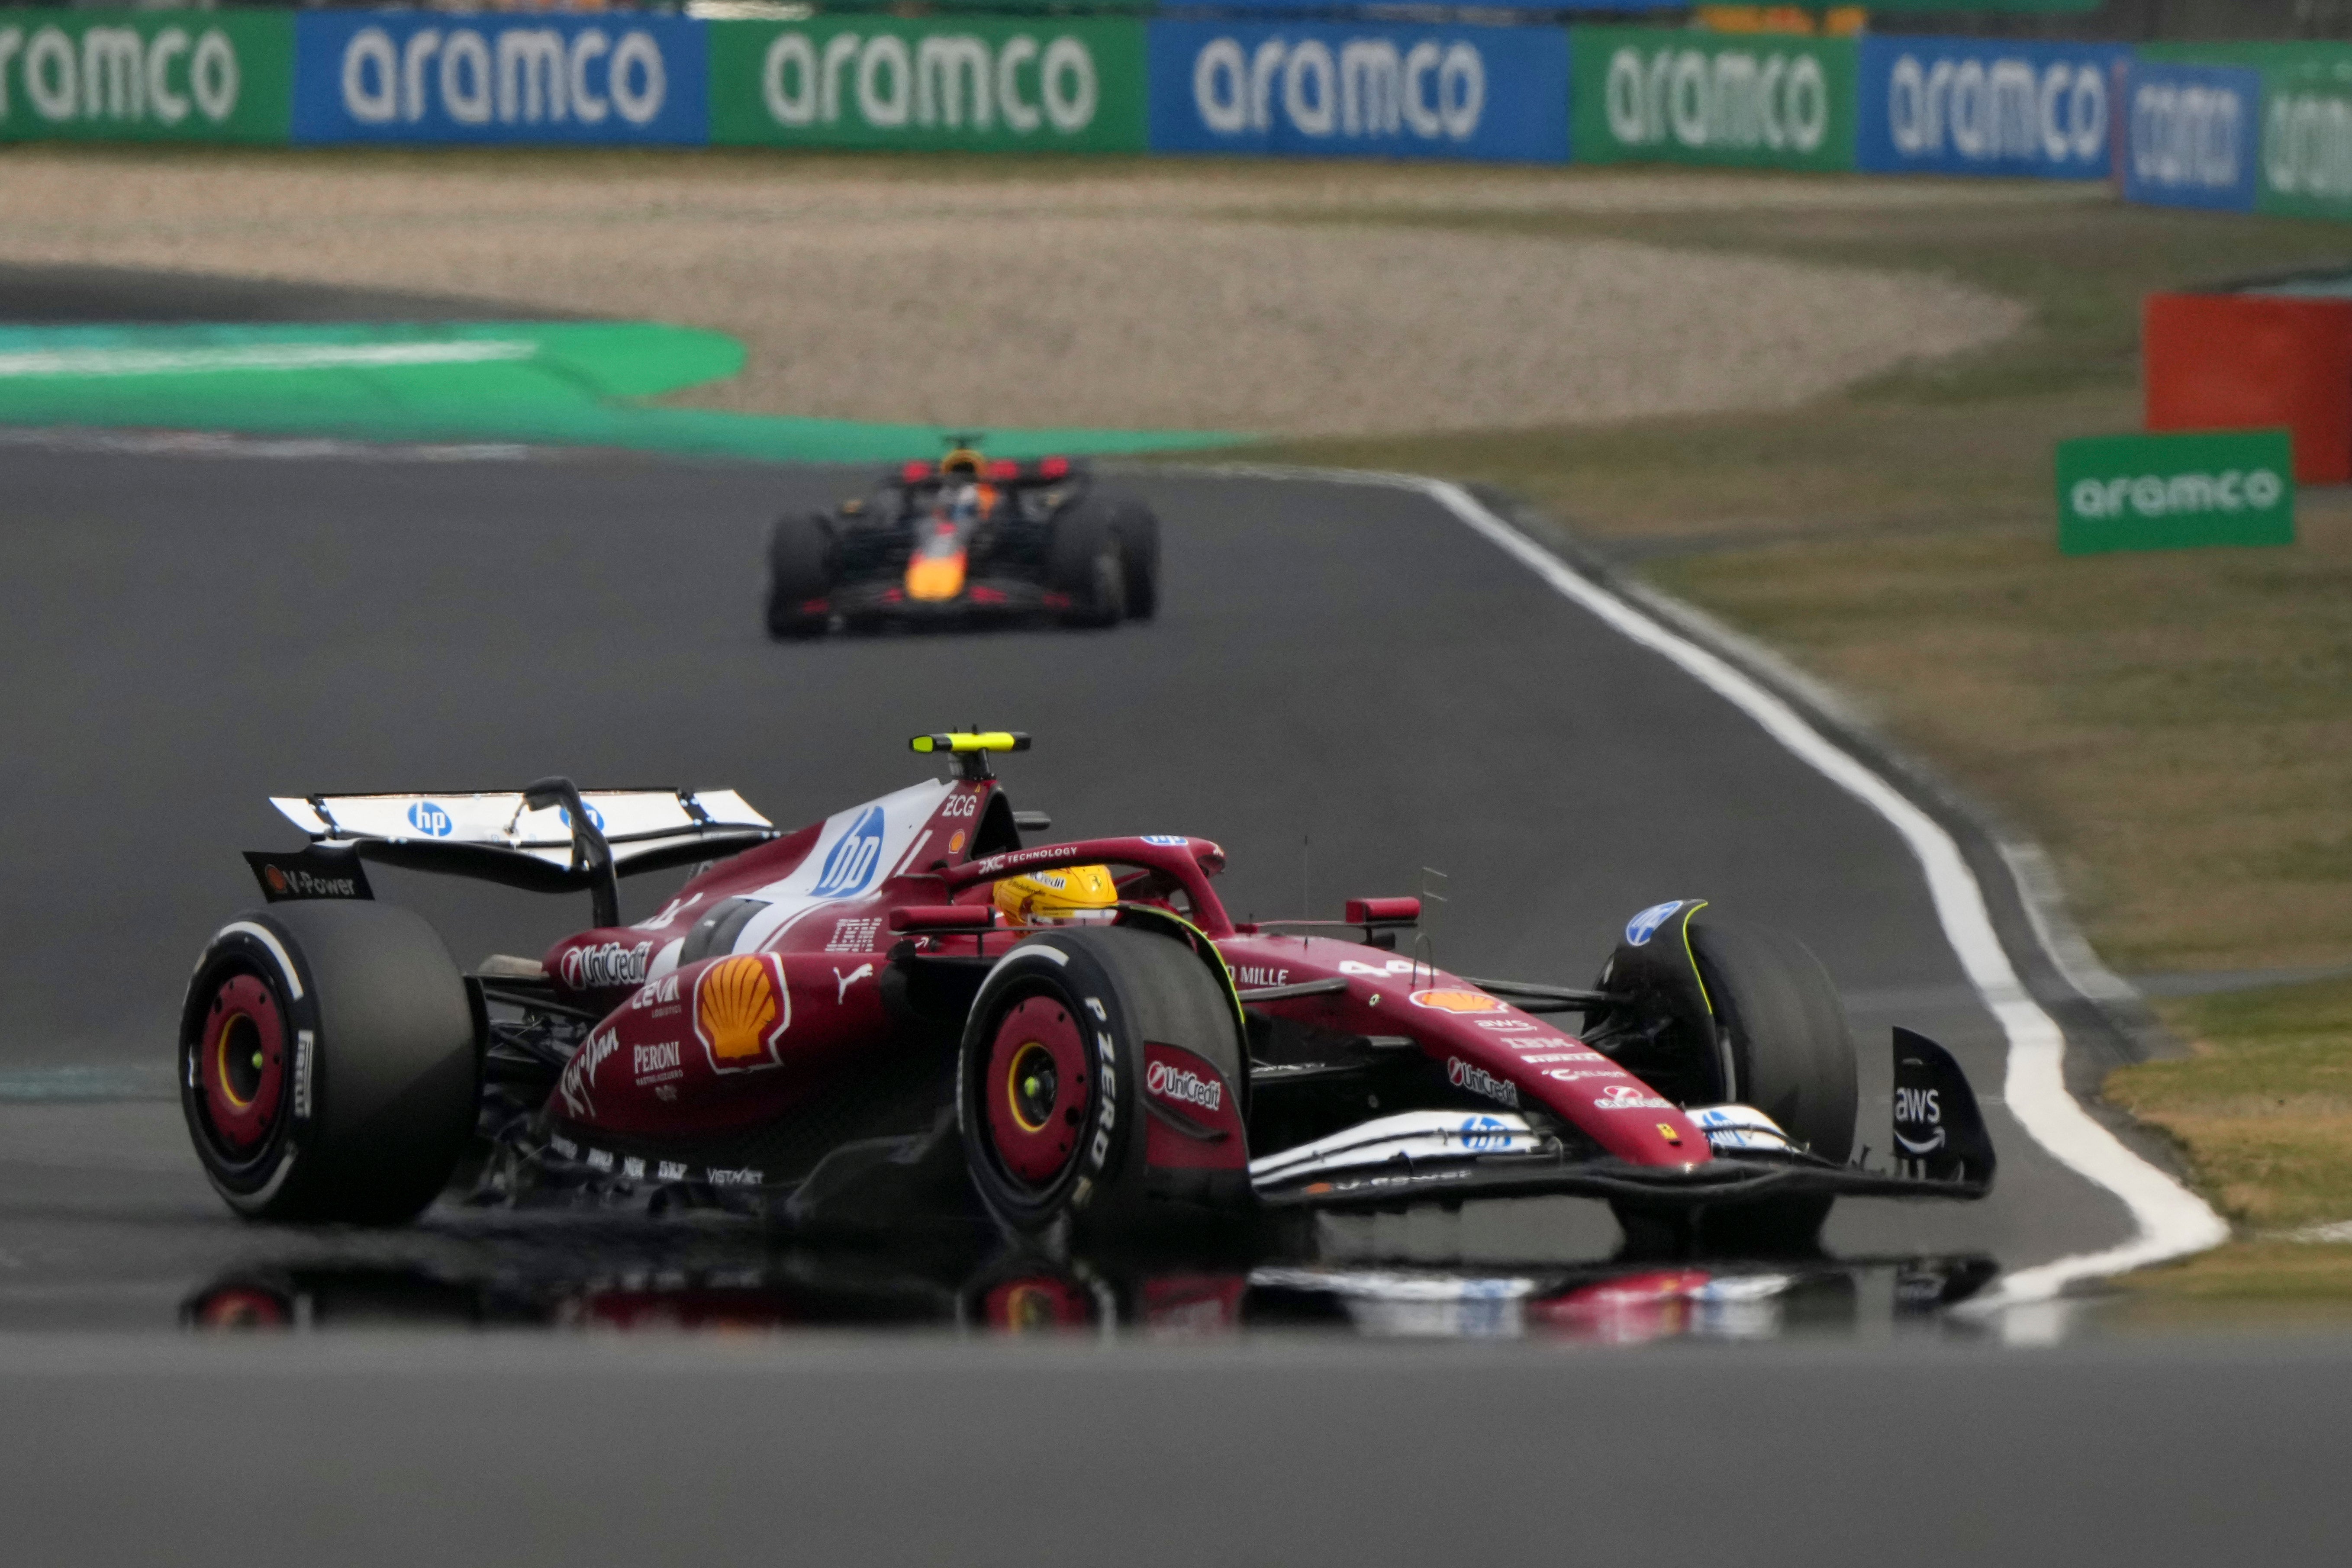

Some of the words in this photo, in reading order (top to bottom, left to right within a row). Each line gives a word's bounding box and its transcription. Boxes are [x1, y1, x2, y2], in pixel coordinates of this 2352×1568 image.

[341, 27, 667, 124] aramco
[763, 31, 1098, 133] aramco
[1193, 36, 1485, 139] aramco
[1605, 46, 1827, 151] aramco
[1889, 55, 2108, 161] aramco
[2071, 468, 2284, 521] aramco
[412, 802, 448, 836] hp
[1007, 847, 1078, 864] TECHNOLOGY
[281, 870, 356, 896] V-Power
[825, 917, 883, 952] IBM
[581, 940, 653, 985] UniCredit
[1240, 967, 1289, 988] MILLE
[632, 975, 680, 1010] CEVA
[1086, 997, 1107, 1021] P
[633, 1041, 680, 1074] PERONI
[1091, 1032, 1116, 1169] ZERO
[1164, 1066, 1221, 1111] UniCredit
[1460, 1064, 1519, 1108] UniCredit
[1895, 1087, 1941, 1124] aws
